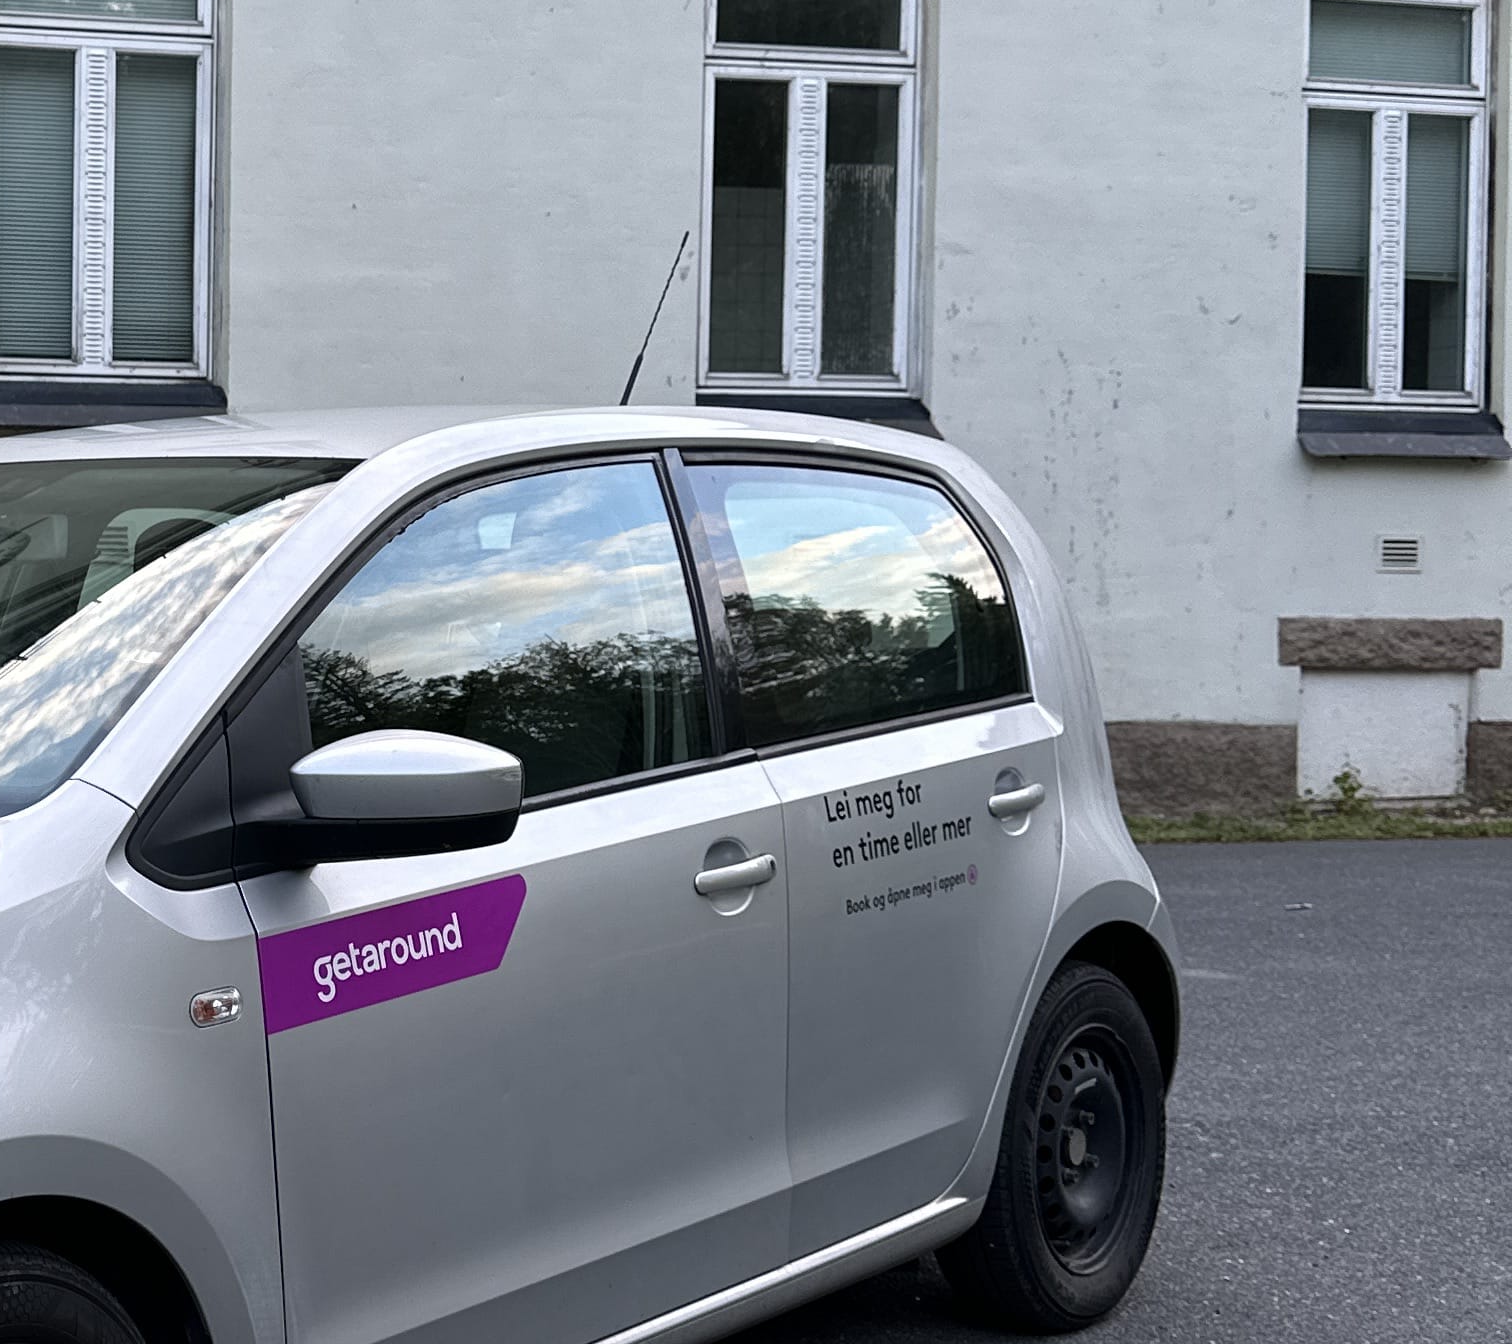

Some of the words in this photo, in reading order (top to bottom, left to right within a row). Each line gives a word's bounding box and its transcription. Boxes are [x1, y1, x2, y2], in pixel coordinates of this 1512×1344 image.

[824, 790, 851, 822] Lei
[855, 791, 894, 819] meg
[897, 779, 921, 806] for
[833, 845, 855, 868] en
[858, 831, 900, 862] time
[904, 821, 937, 851] eller
[942, 816, 972, 841] mer
[846, 895, 871, 915] Book
[873, 894, 885, 911] og
[888, 887, 911, 907] åpne
[913, 880, 932, 898] meg
[939, 872, 966, 893] appen
[313, 912, 463, 1003] getaround
